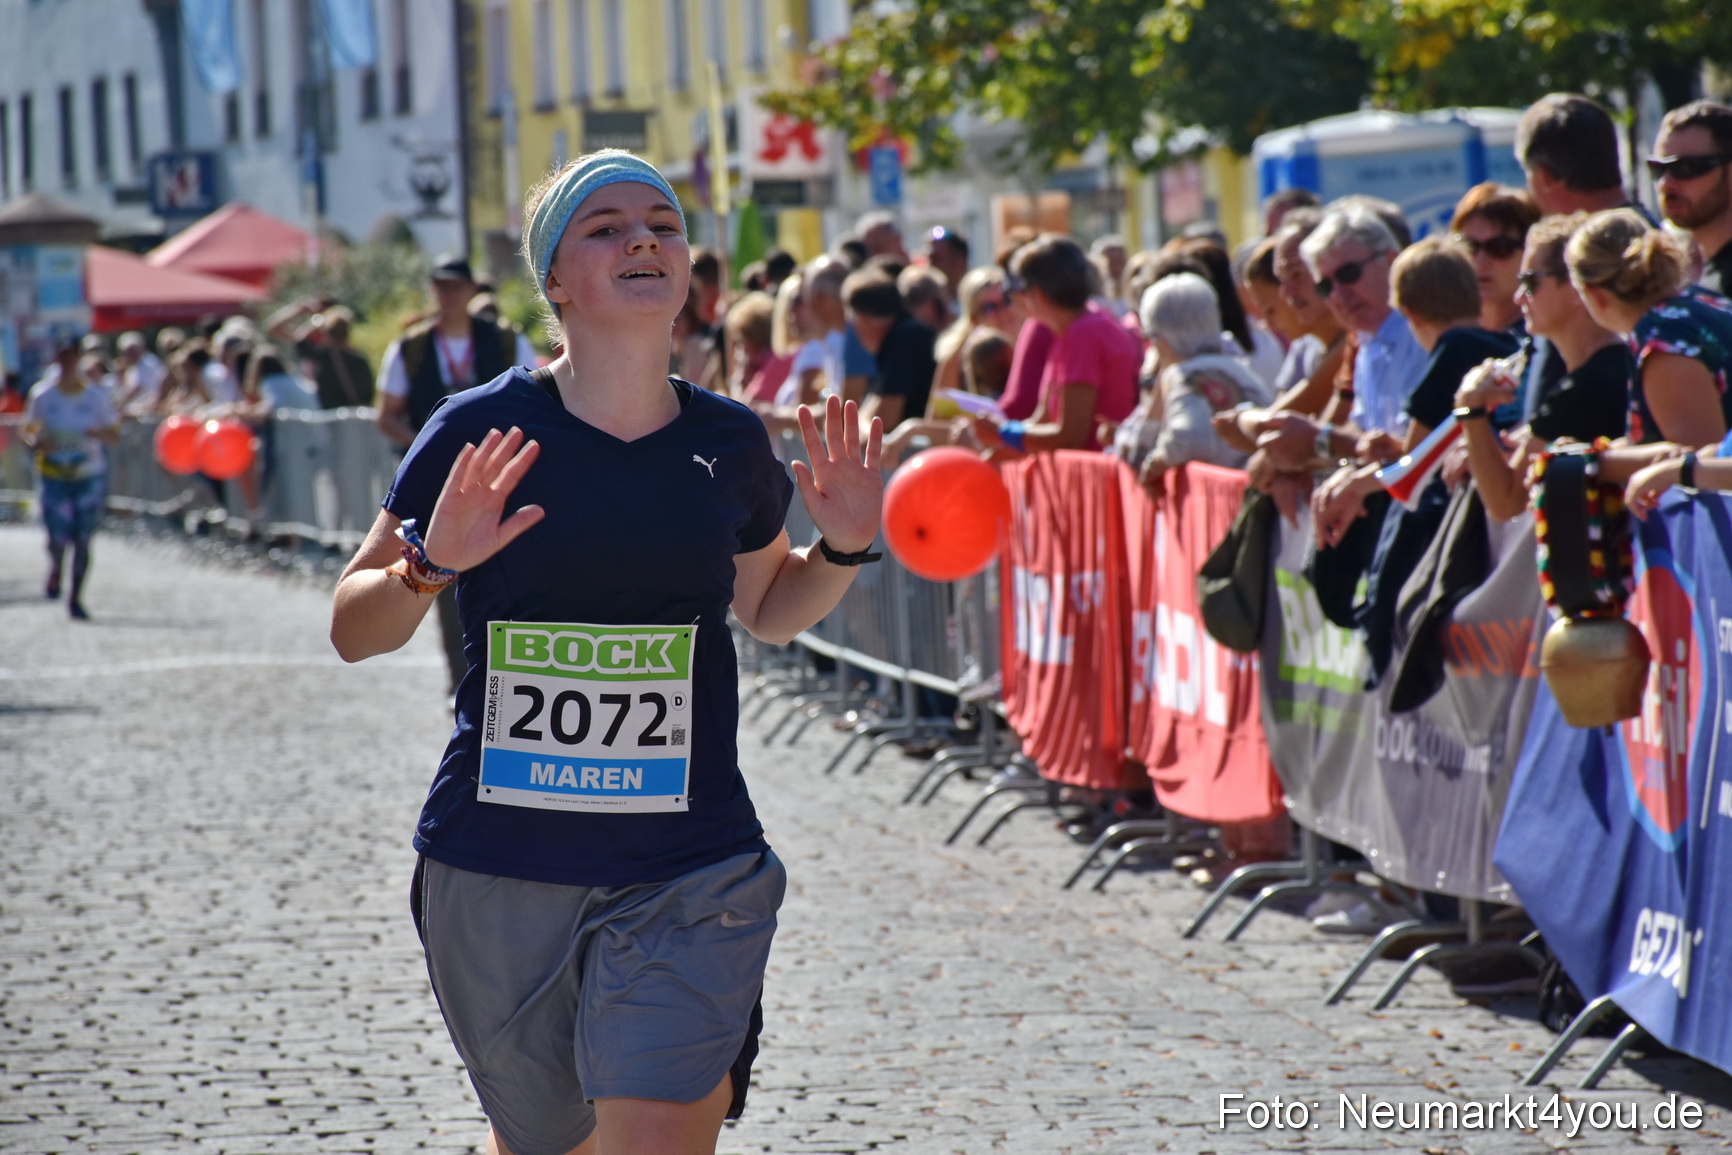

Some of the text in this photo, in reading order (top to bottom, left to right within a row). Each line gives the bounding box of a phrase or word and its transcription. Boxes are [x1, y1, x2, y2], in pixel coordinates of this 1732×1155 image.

[505, 628, 677, 674] BOCK
[509, 685, 667, 747] 2072
[674, 696, 684, 707] D
[530, 762, 643, 790] MAREN
